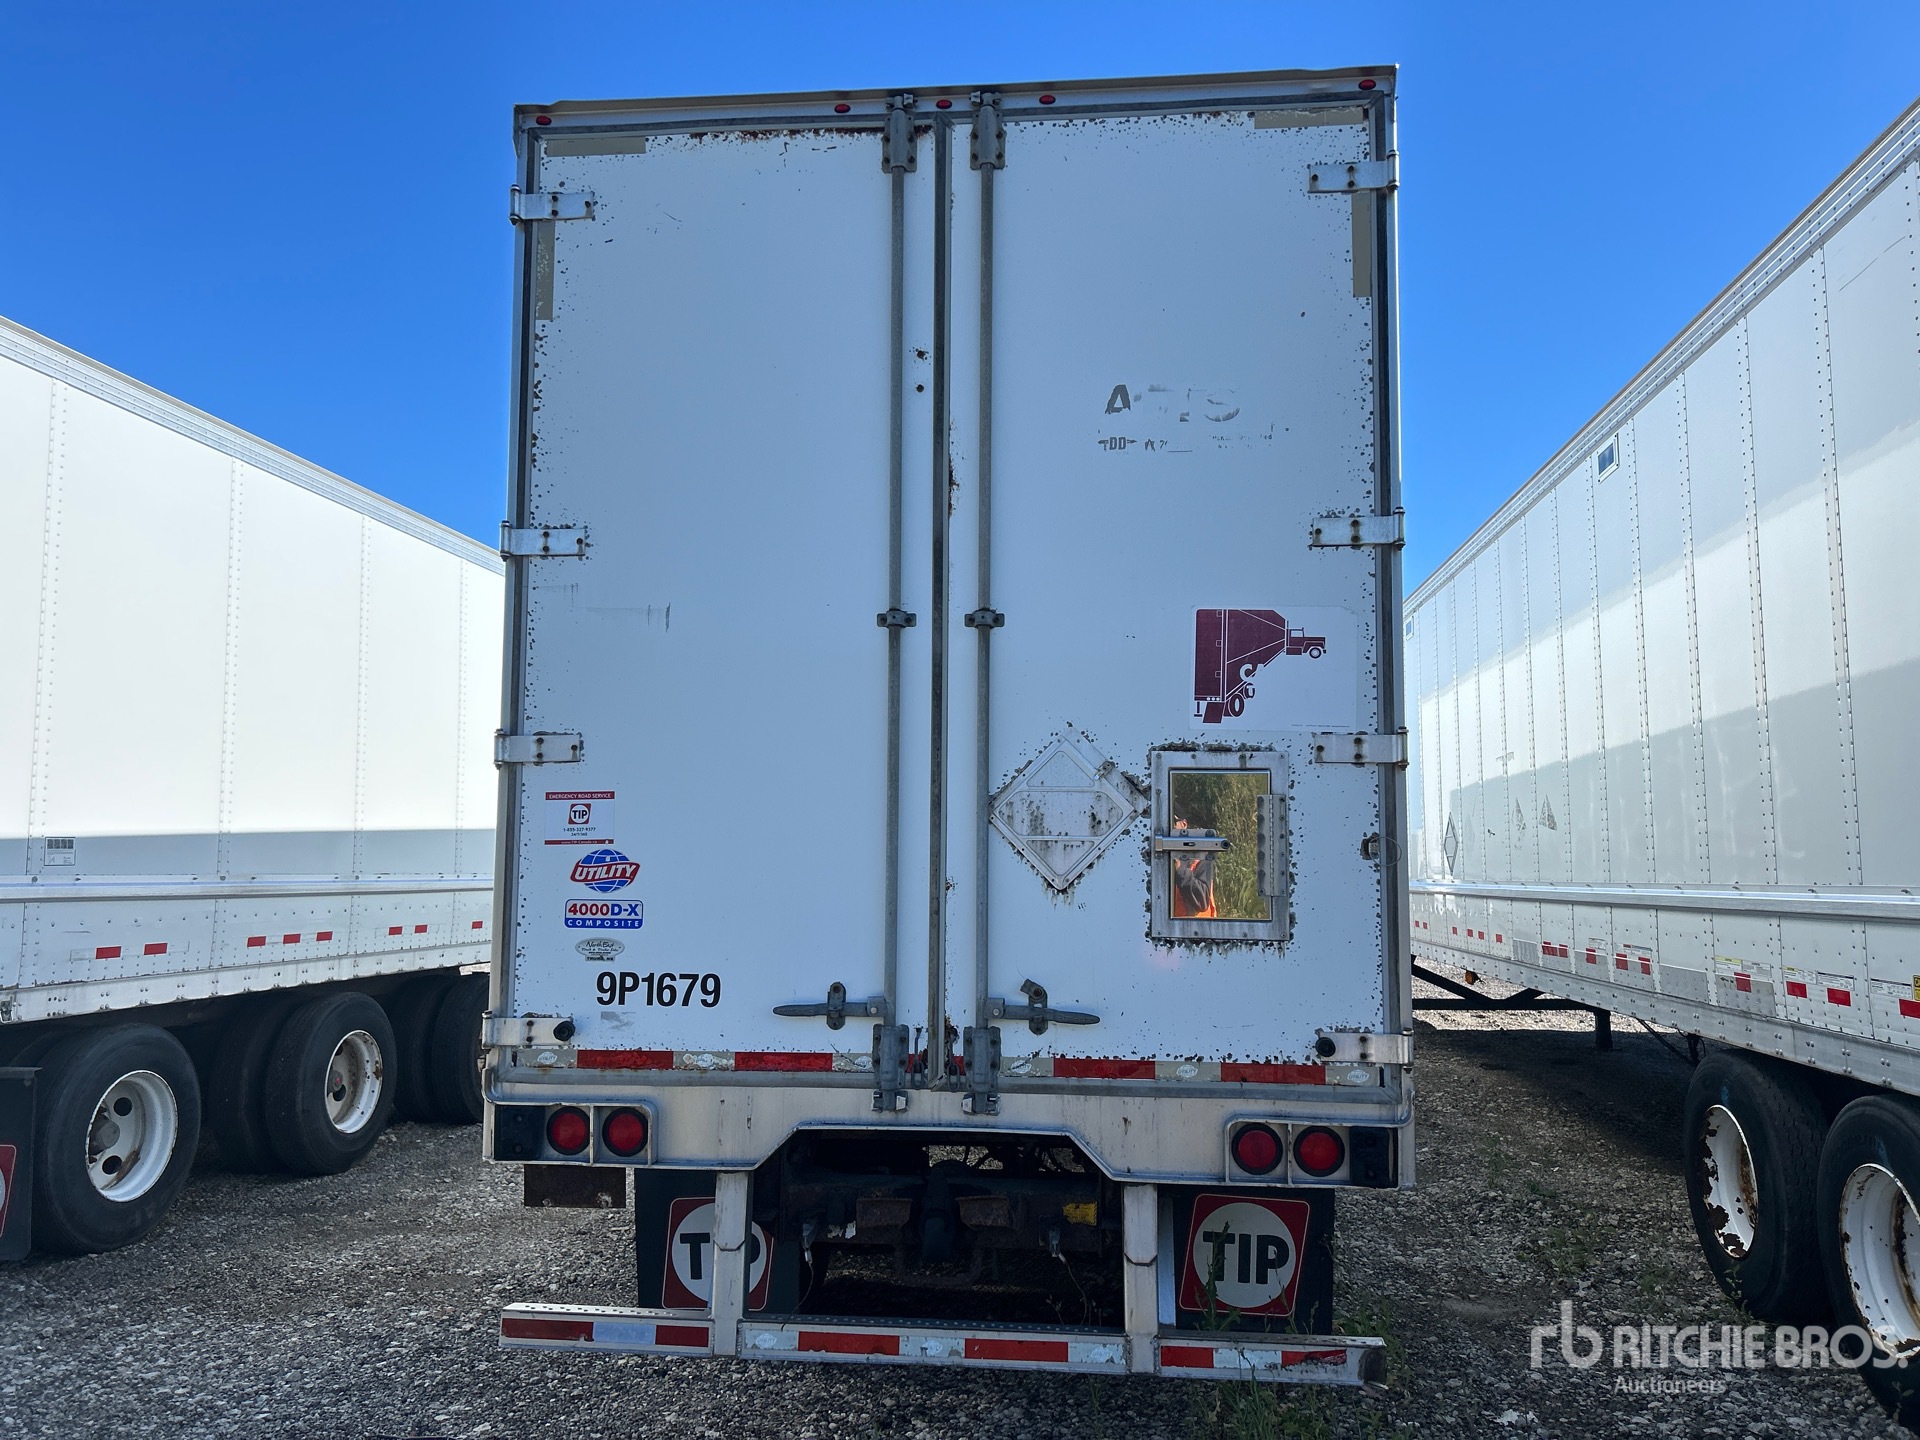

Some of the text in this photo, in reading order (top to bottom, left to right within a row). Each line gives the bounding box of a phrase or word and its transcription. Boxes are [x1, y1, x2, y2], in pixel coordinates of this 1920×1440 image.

[572, 810, 587, 819] TIP
[574, 864, 636, 880] UTILITY
[568, 903, 640, 916] 4000D-X
[567, 919, 639, 927] COMPOSITE
[596, 971, 721, 1008] 9P1679
[1202, 1230, 1290, 1284] TIP
